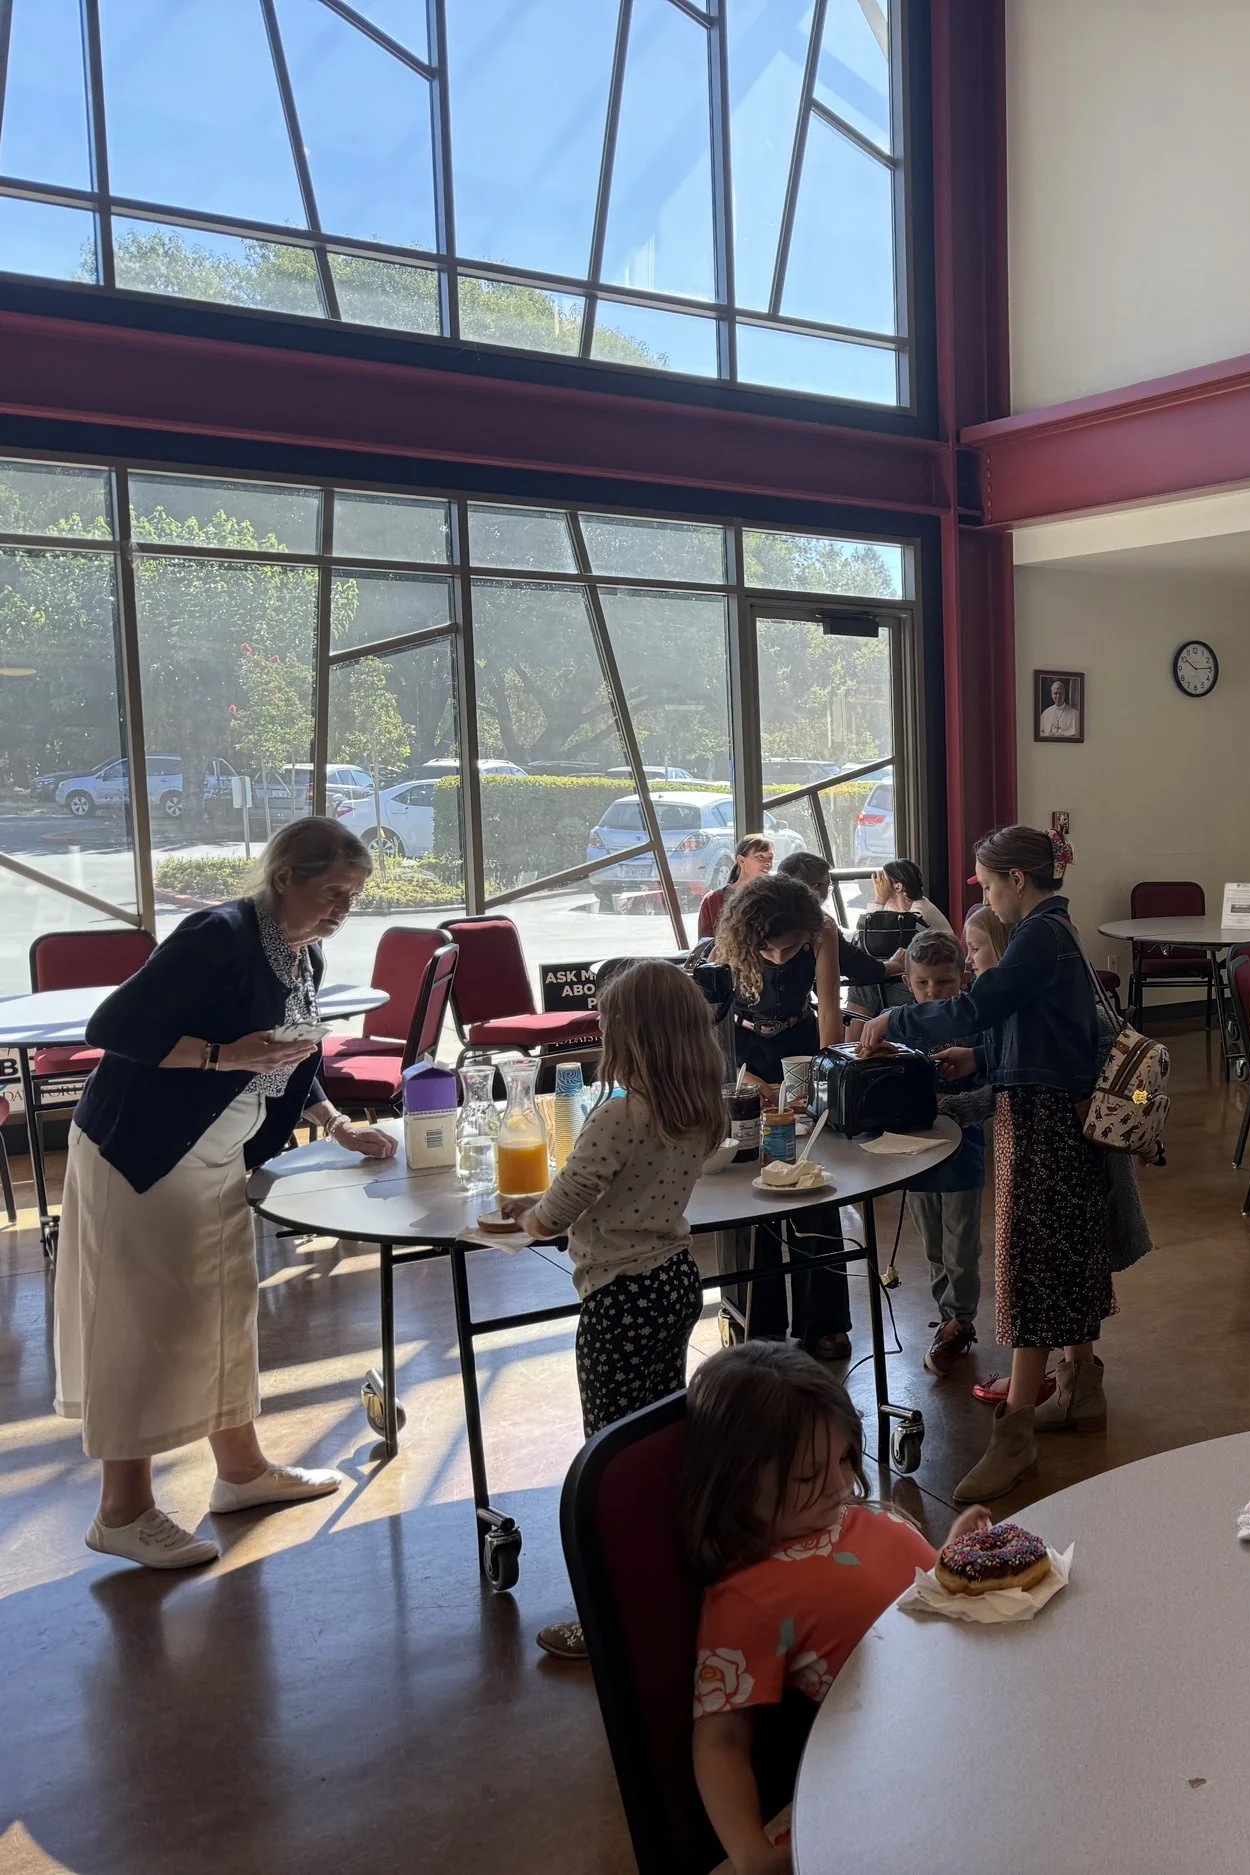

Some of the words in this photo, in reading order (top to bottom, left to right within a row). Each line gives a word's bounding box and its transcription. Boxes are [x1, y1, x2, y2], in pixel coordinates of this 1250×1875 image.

[545, 971, 577, 984] ASK
[581, 970, 597, 980] M
[562, 984, 596, 997] ABO
